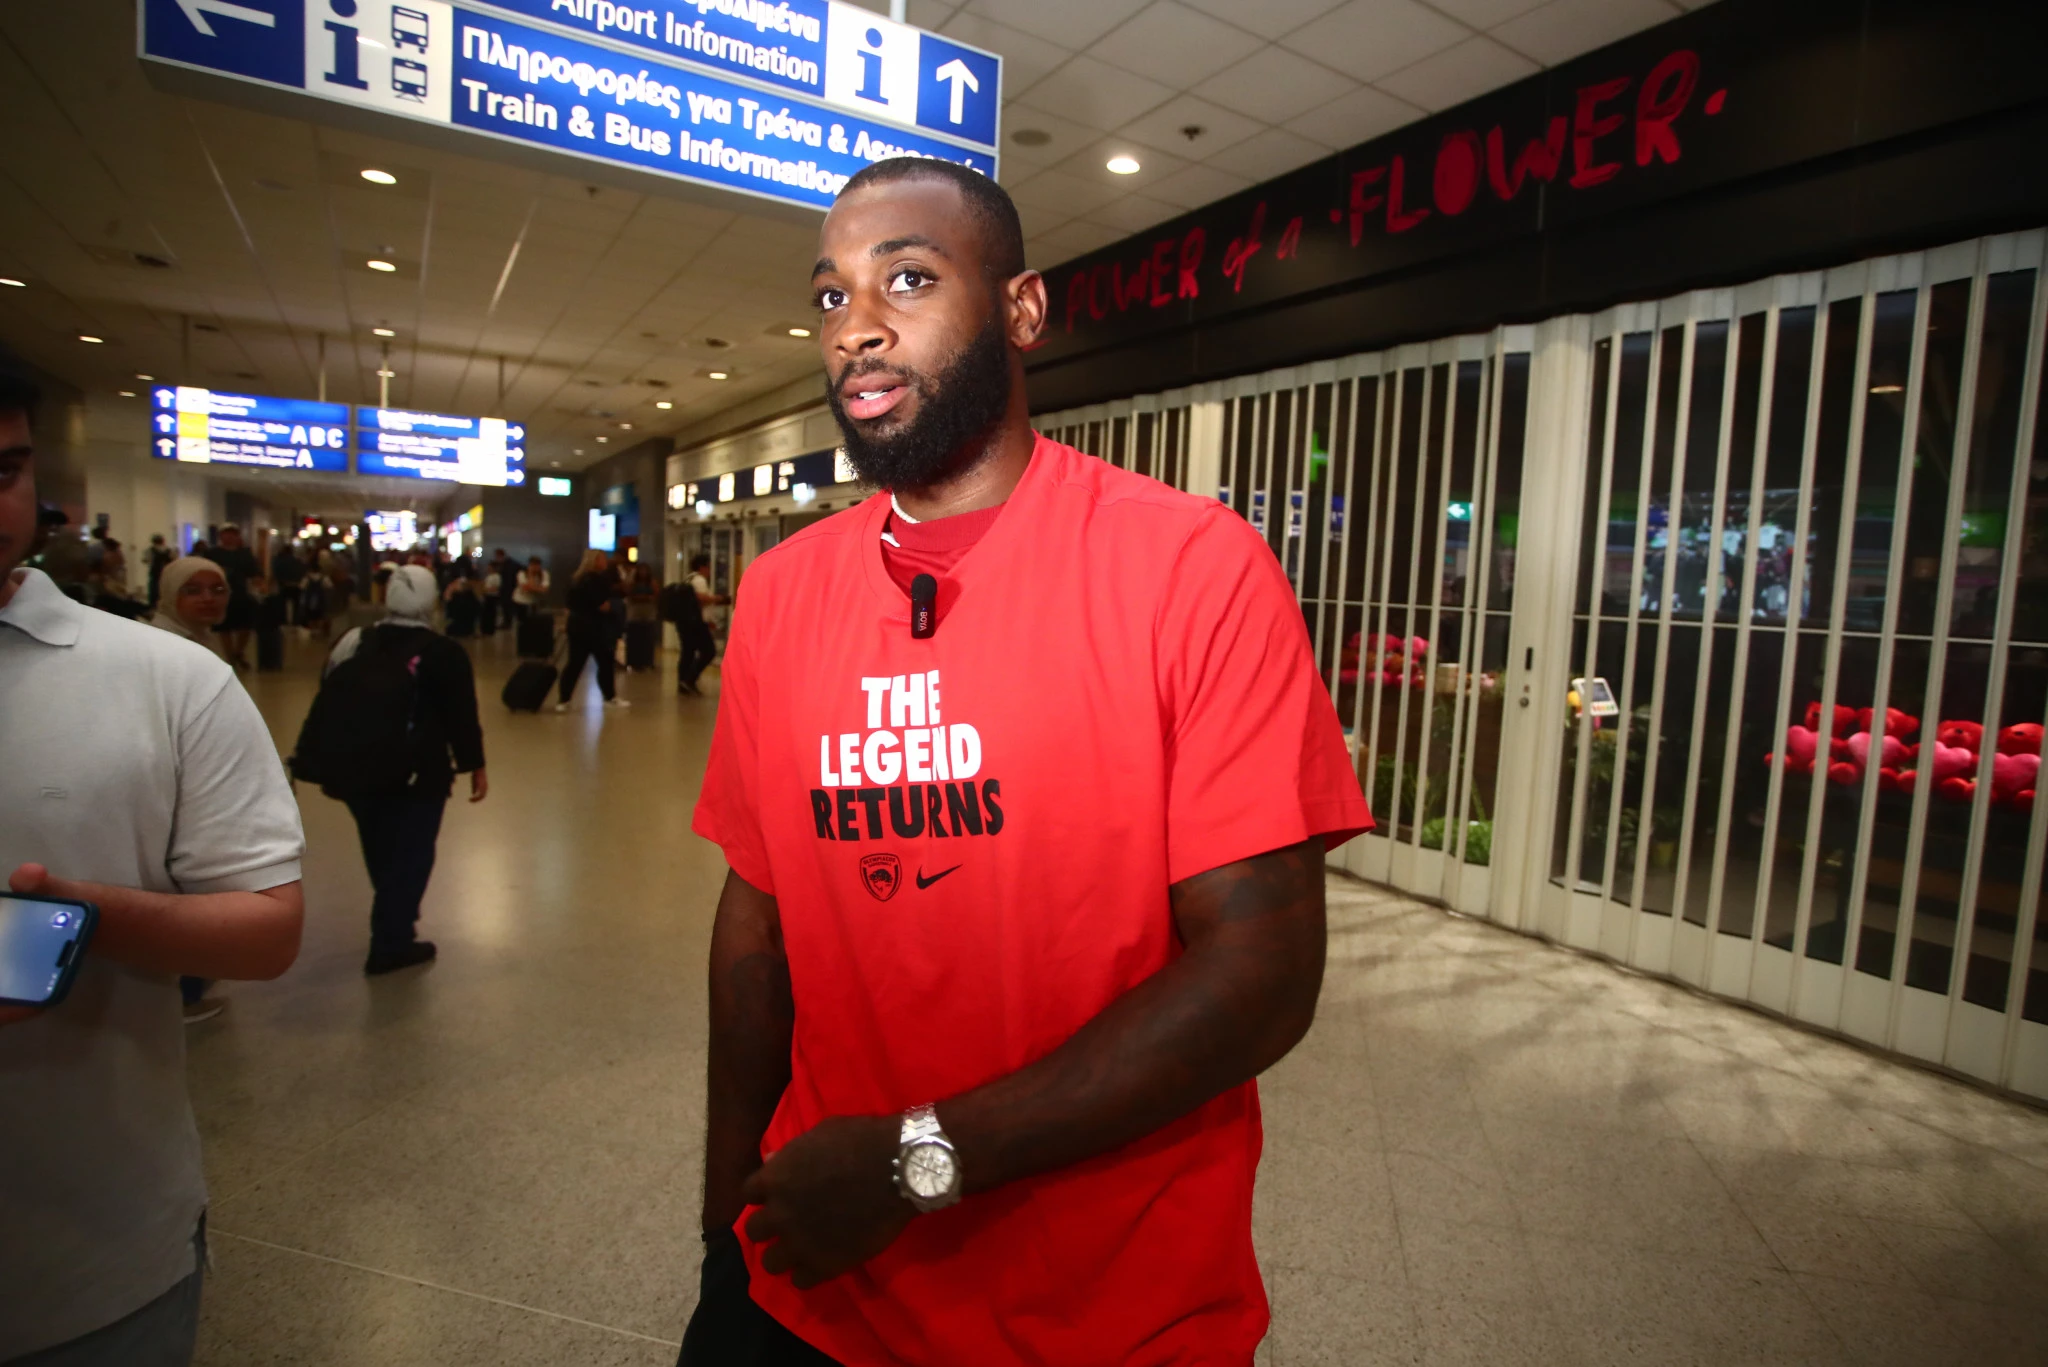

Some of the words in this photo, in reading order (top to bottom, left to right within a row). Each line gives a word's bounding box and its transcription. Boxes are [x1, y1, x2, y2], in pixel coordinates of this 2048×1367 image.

[665, 11, 818, 85] Information
[461, 77, 558, 131] Train
[568, 105, 595, 140] &
[605, 112, 671, 156] Bus
[462, 25, 681, 119] Πληροφορίες
[686, 91, 732, 124] για
[738, 98, 822, 147] Τρένα
[827, 124, 848, 154] &
[1066, 226, 1206, 333] POWER
[1222, 202, 1267, 293] of
[861, 670, 941, 729] THE
[820, 723, 982, 787] LEGEND
[810, 778, 1004, 841] RETURNS
